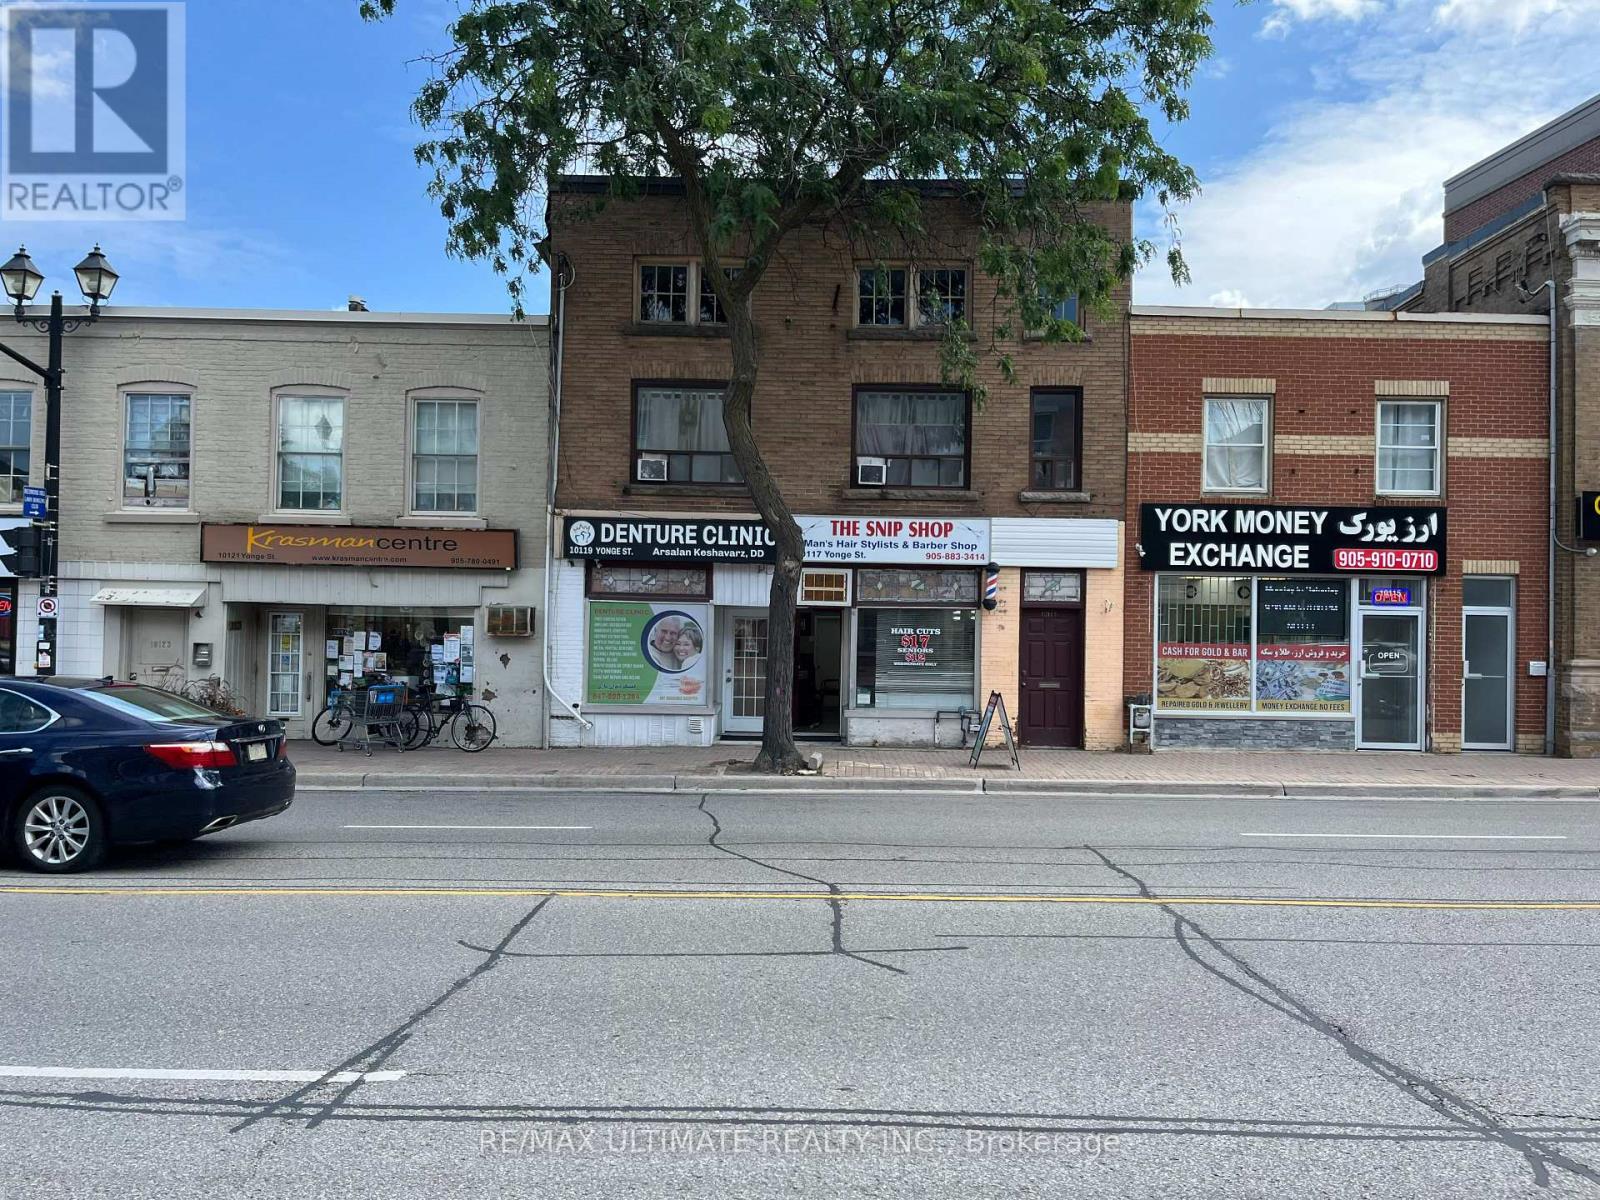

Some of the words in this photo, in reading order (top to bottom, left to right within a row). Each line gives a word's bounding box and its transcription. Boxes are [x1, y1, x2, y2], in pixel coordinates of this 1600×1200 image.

[1155, 508, 1228, 532] YORK
[1234, 510, 1328, 535] MONEY
[601, 523, 698, 544] DENTURE
[702, 525, 776, 546] CLINIC
[830, 520, 860, 536] THE
[866, 521, 903, 537] SNIP
[908, 522, 954, 538] SHOP
[570, 546, 592, 555] 10119
[596, 547, 621, 556] YONGE
[622, 548, 634, 556] ST.
[804, 540, 833, 548] Man's
[836, 540, 858, 548] Hair
[860, 540, 900, 550] Stylists
[902, 541, 909, 549] &
[912, 541, 948, 550] Barber
[950, 542, 978, 552] Shop
[240, 552, 264, 560] Yonge
[652, 548, 692, 557] Arsalan
[694, 548, 748, 559] Keshavarz,
[750, 549, 764, 558] DD
[824, 550, 852, 560] Yonge
[855, 551, 866, 559] St.
[926, 552, 986, 561] 905-883-3414
[1169, 543, 1309, 568] EXCHANGE
[1338, 551, 1434, 568] 905-910-0710
[1374, 592, 1408, 603] OPEN
[901, 634, 930, 649] $17
[1162, 646, 1183, 656] CASH
[1184, 647, 1200, 656] FOR
[1202, 648, 1222, 657] GOLD
[1224, 648, 1230, 657] &
[1232, 648, 1248, 657] BAR
[1262, 702, 1284, 710] MONEY
[1286, 702, 1318, 710] EXCHANGE
